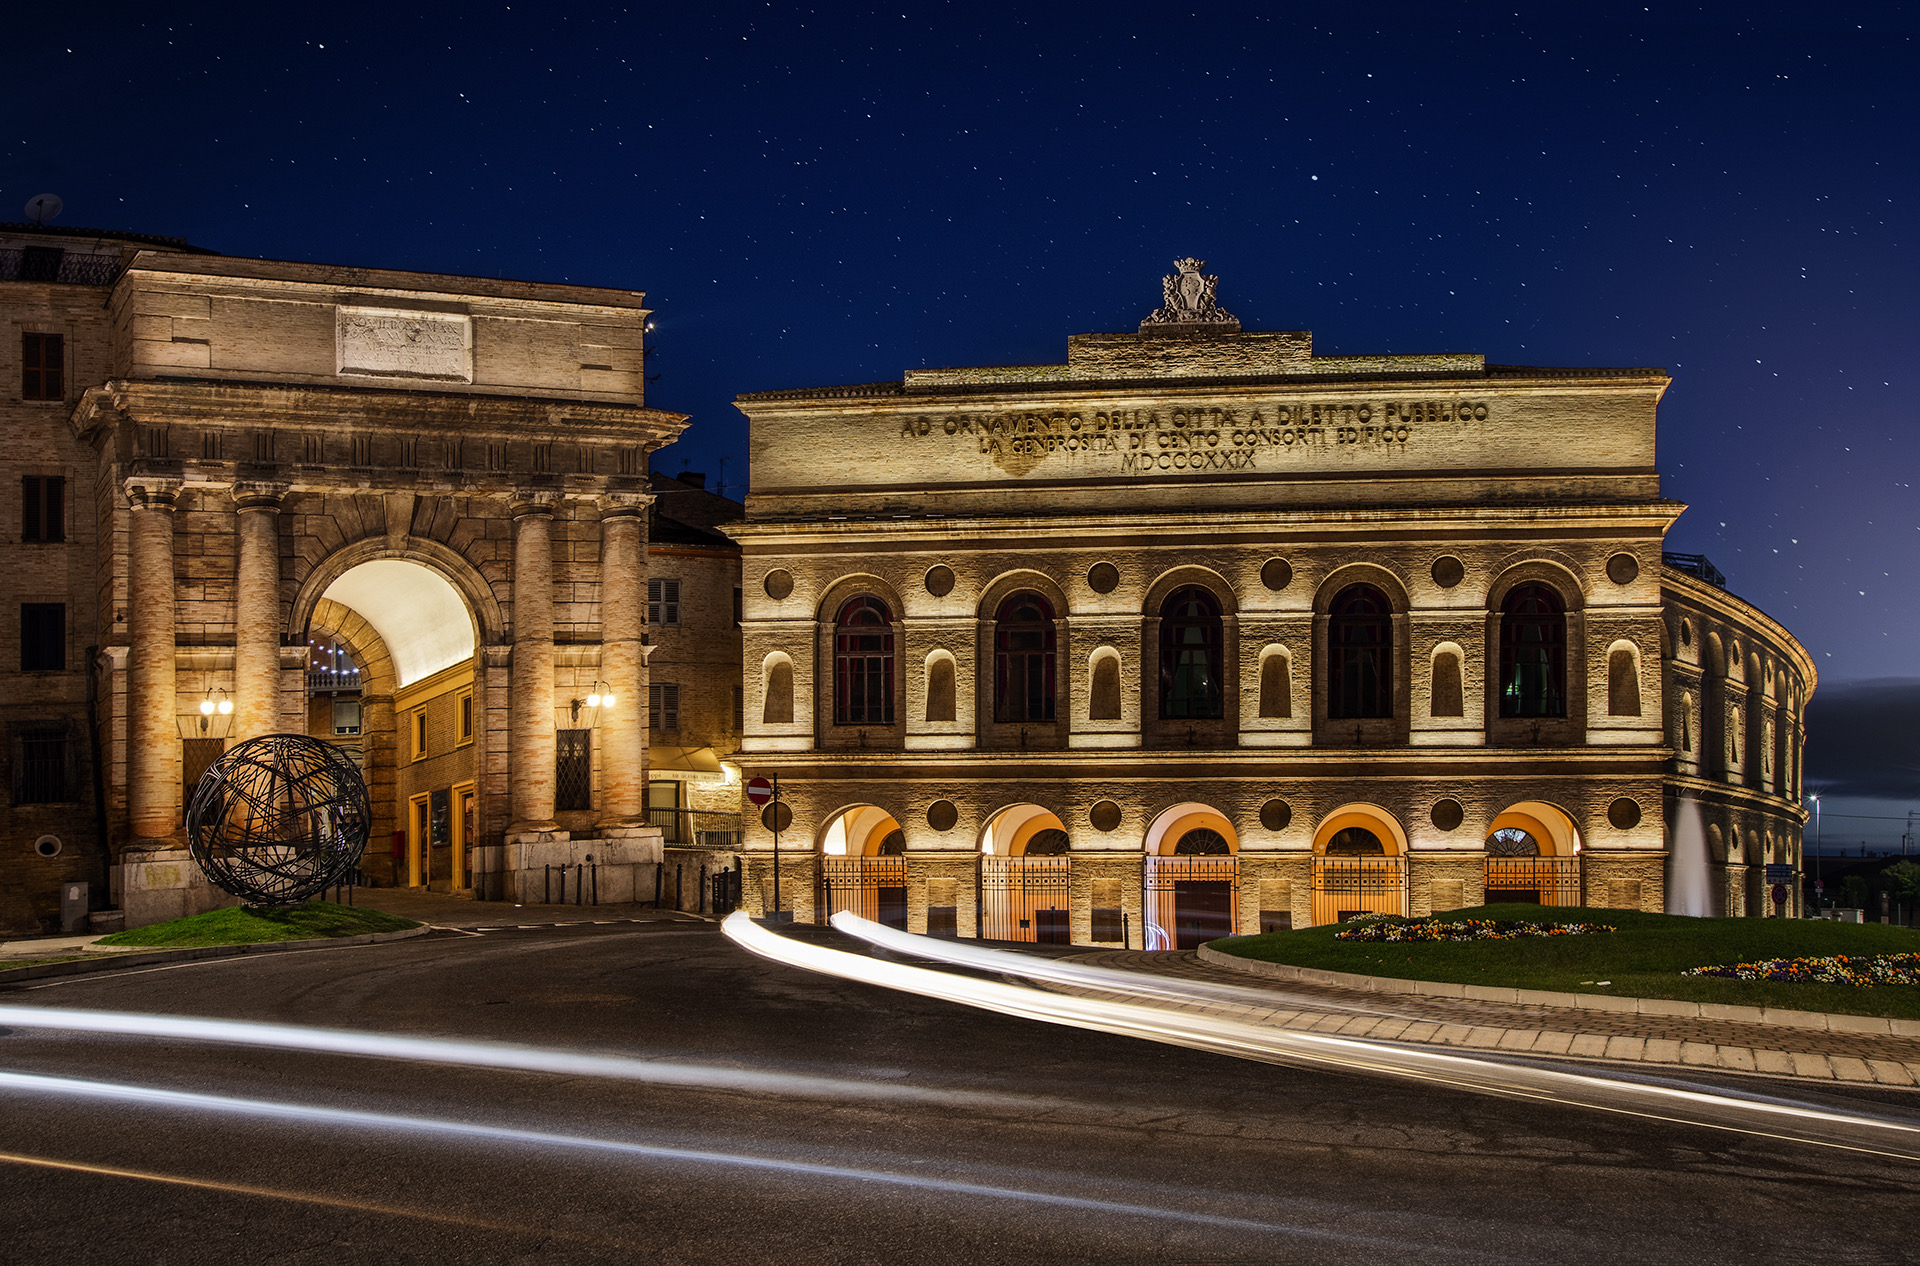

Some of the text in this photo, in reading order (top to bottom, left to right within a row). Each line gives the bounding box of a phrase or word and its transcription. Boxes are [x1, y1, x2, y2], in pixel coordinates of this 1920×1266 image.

[901, 417, 931, 437] AD
[943, 414, 1083, 436] ORNAMENTO
[1095, 412, 1161, 431] DELLA
[1249, 410, 1264, 427] A
[1277, 406, 1373, 426] DILETTO
[1385, 402, 1488, 422] PUBBLICO
[980, 439, 1002, 455] LA
[1129, 433, 1146, 450] DI
[1157, 431, 1219, 449] CENTO
[1232, 429, 1325, 447] CONSORTI
[1120, 450, 1256, 473] MDCCCXXIX
